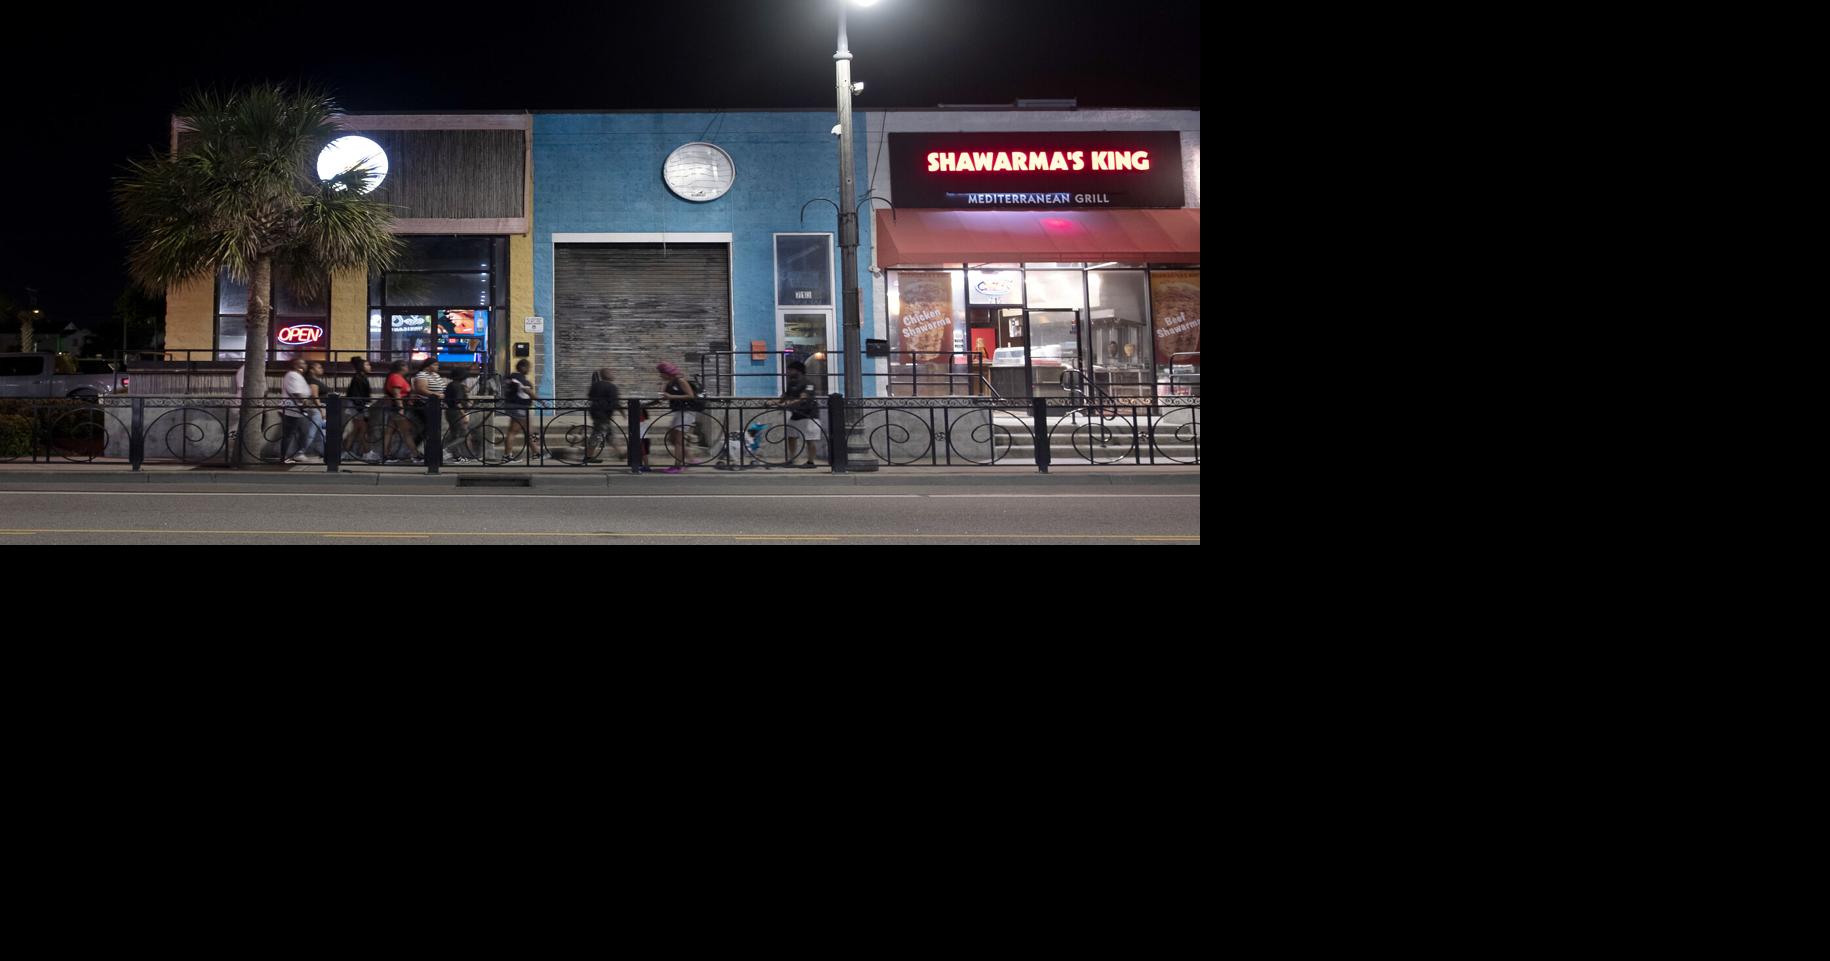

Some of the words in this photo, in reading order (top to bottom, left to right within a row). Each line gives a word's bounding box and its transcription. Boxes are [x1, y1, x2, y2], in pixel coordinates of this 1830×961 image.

[927, 151, 1084, 172] SHAWARMA'S
[1091, 151, 1150, 171] KING
[968, 193, 1070, 204] MEDITERRANEAN
[1075, 193, 1110, 203] GRILL
[903, 309, 942, 326] Chicken
[1164, 312, 1186, 326] Beef
[279, 327, 320, 342] OPEN
[902, 317, 952, 338] Shawarma
